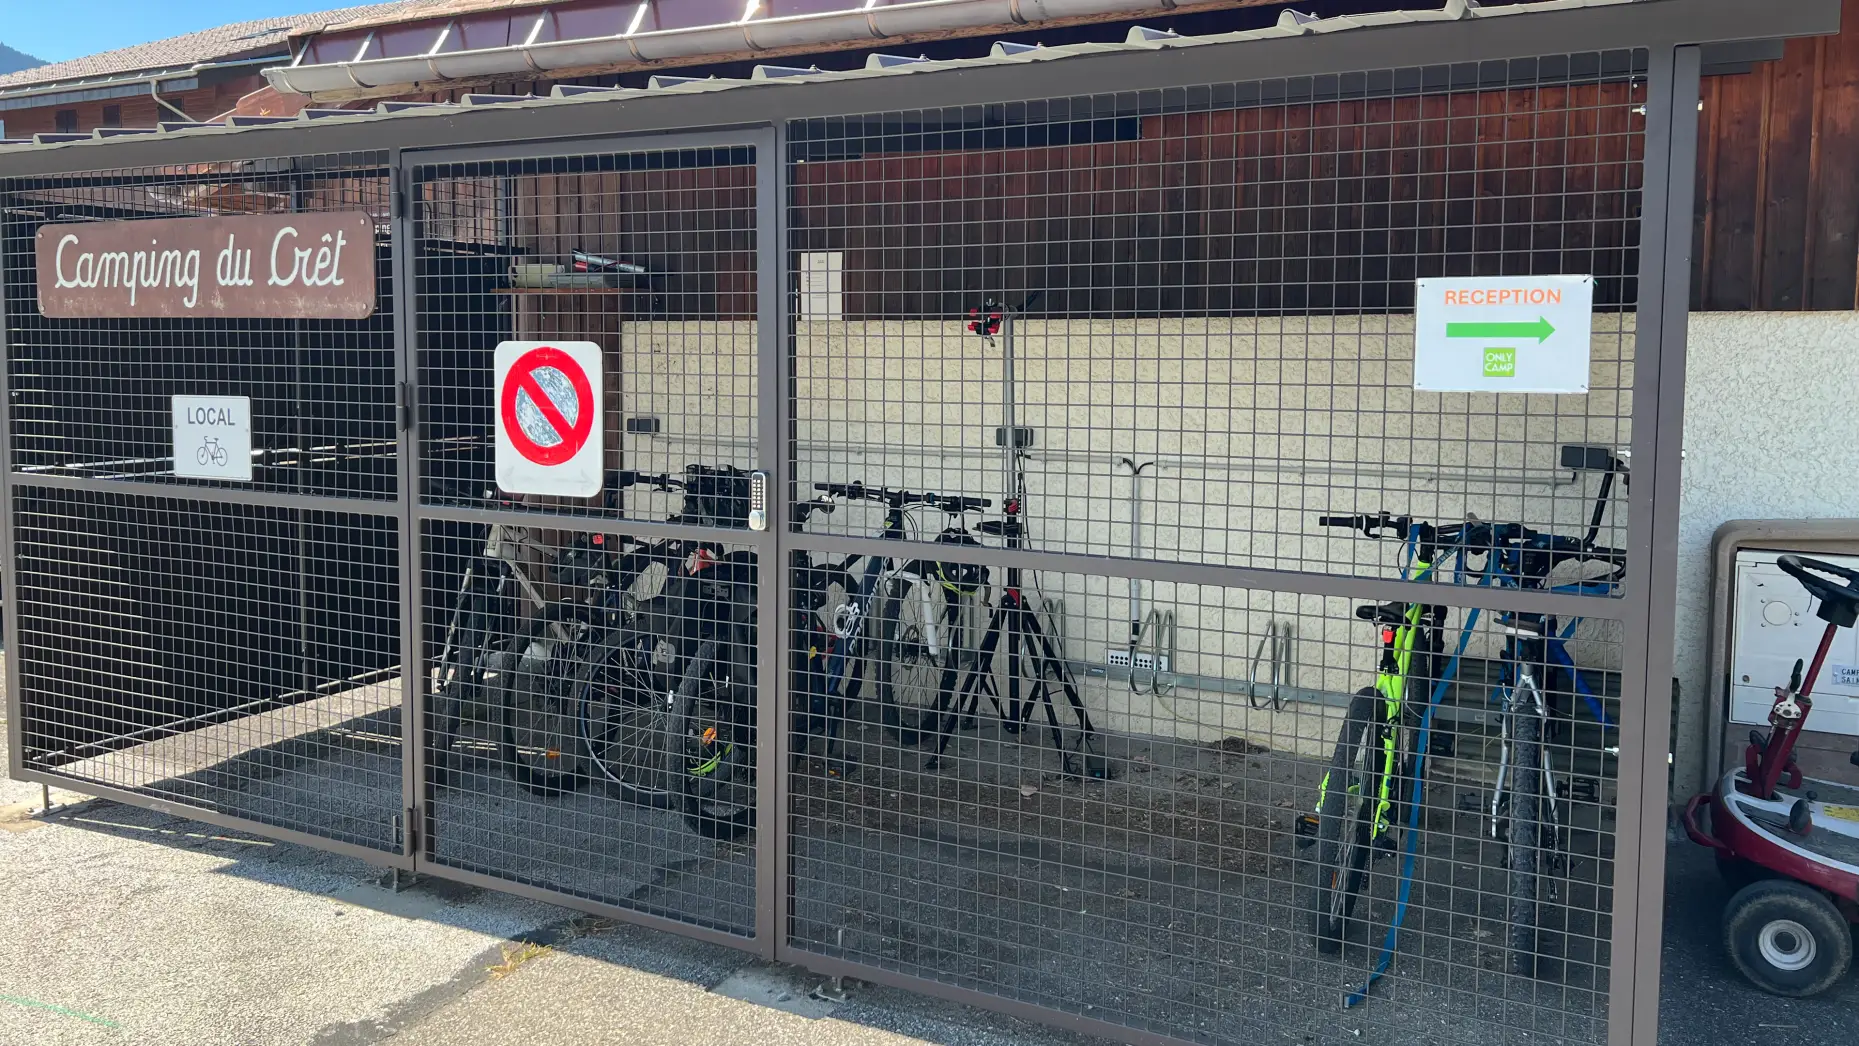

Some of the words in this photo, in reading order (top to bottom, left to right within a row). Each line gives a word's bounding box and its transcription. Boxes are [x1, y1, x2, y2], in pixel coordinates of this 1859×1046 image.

[54, 233, 201, 308] Camping
[215, 233, 254, 287] du
[267, 226, 347, 287] Crêt
[1444, 288, 1562, 305] RECEPTION
[1485, 352, 1513, 362] ONLY
[1484, 362, 1513, 372] CAMP
[187, 406, 236, 426] LOCAL
